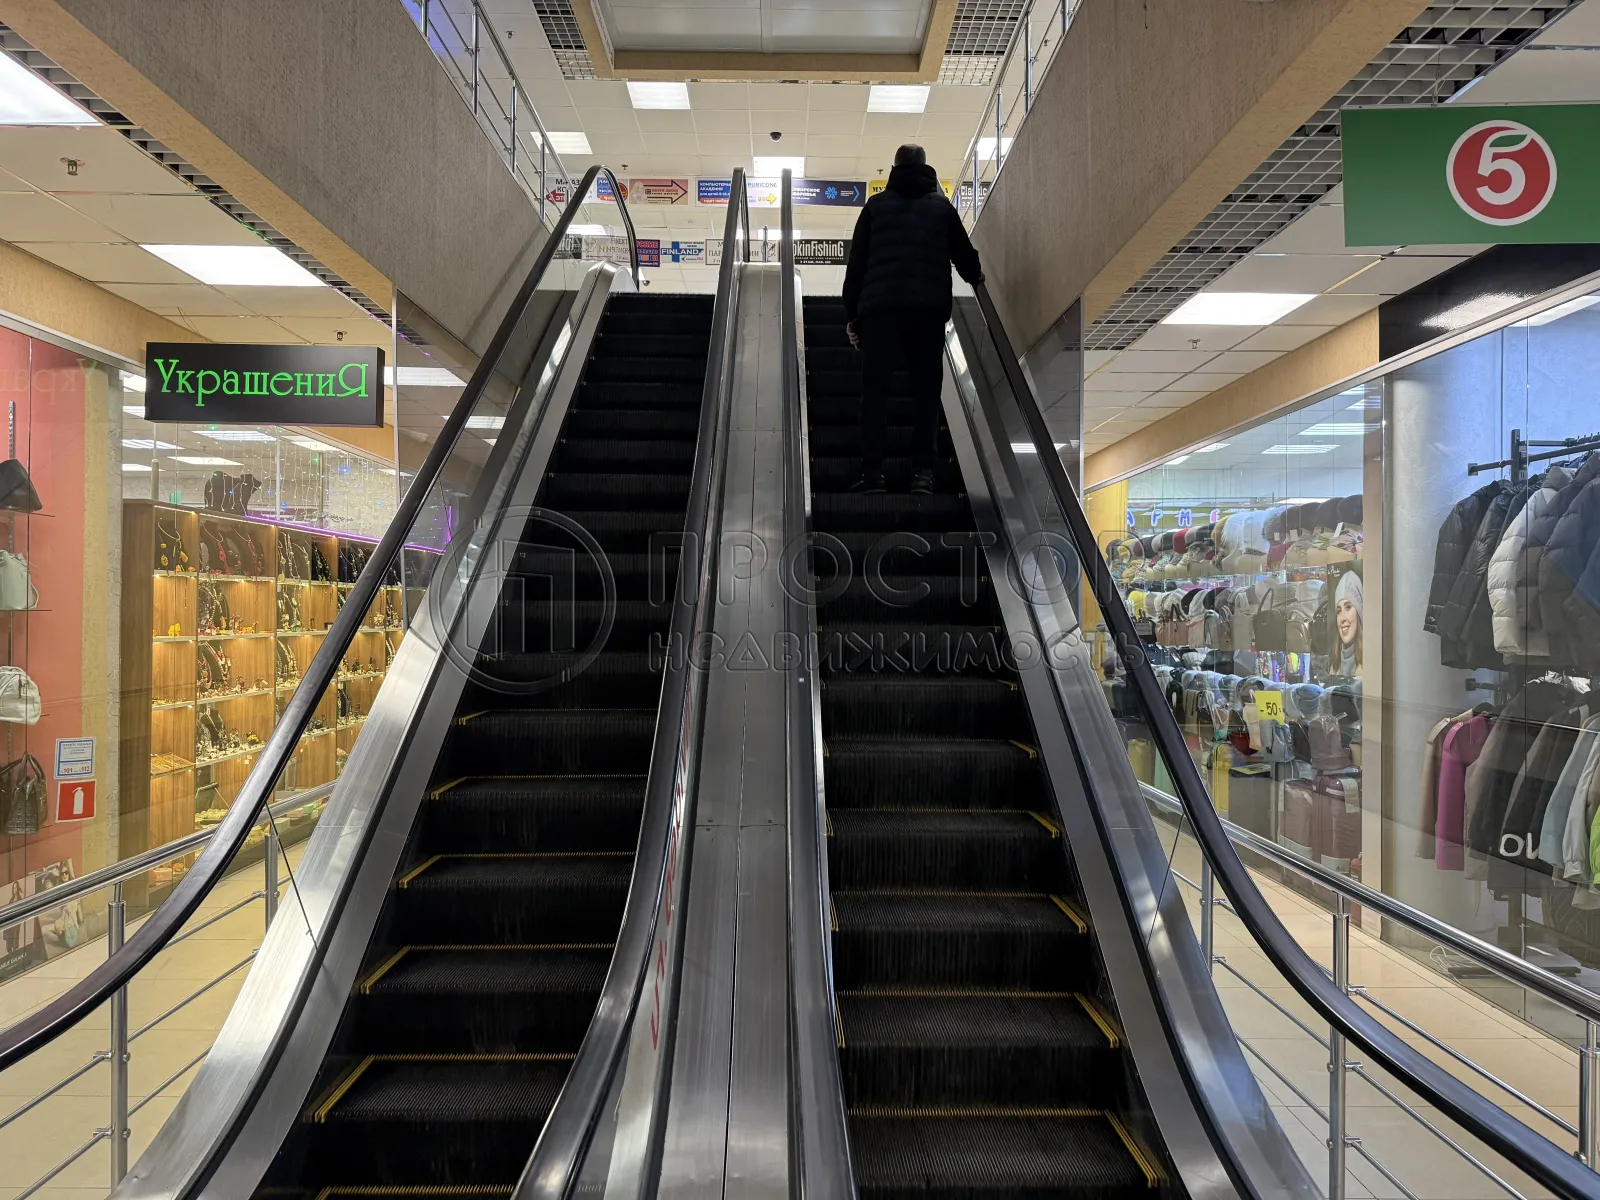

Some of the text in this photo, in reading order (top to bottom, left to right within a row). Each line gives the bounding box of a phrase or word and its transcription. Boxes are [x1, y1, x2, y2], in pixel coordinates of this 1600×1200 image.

[1476, 129, 1532, 206] 5
[661, 247, 700, 255] FINLAND
[154, 358, 369, 407] УкрашениЯ
